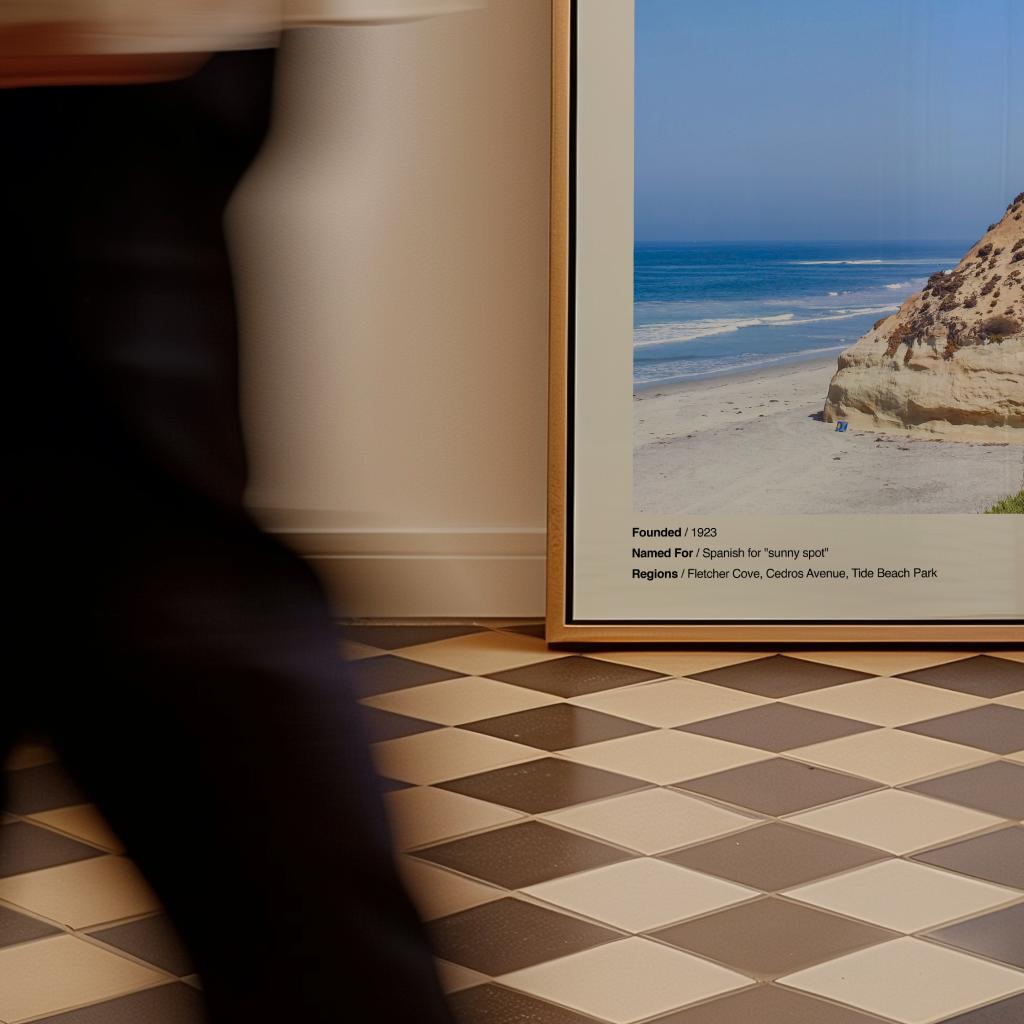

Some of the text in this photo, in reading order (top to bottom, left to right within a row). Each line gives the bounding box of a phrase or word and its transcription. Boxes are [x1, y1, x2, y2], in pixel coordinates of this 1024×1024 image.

[632, 528, 682, 537] Founded
[692, 528, 717, 537] 1923
[632, 548, 671, 558] Named
[675, 548, 693, 558] For
[702, 548, 744, 560] Spanish
[748, 548, 761, 558] for
[764, 548, 800, 560] "sunny
[802, 548, 829, 560] spot"
[632, 569, 678, 581] Regions
[688, 568, 729, 578] Fletcher
[732, 569, 763, 580] Cove,
[766, 568, 804, 578] Cedros
[806, 568, 849, 579] Avenue,
[852, 568, 874, 578] Tide
[877, 568, 910, 578] Beach
[913, 568, 938, 578] Park
